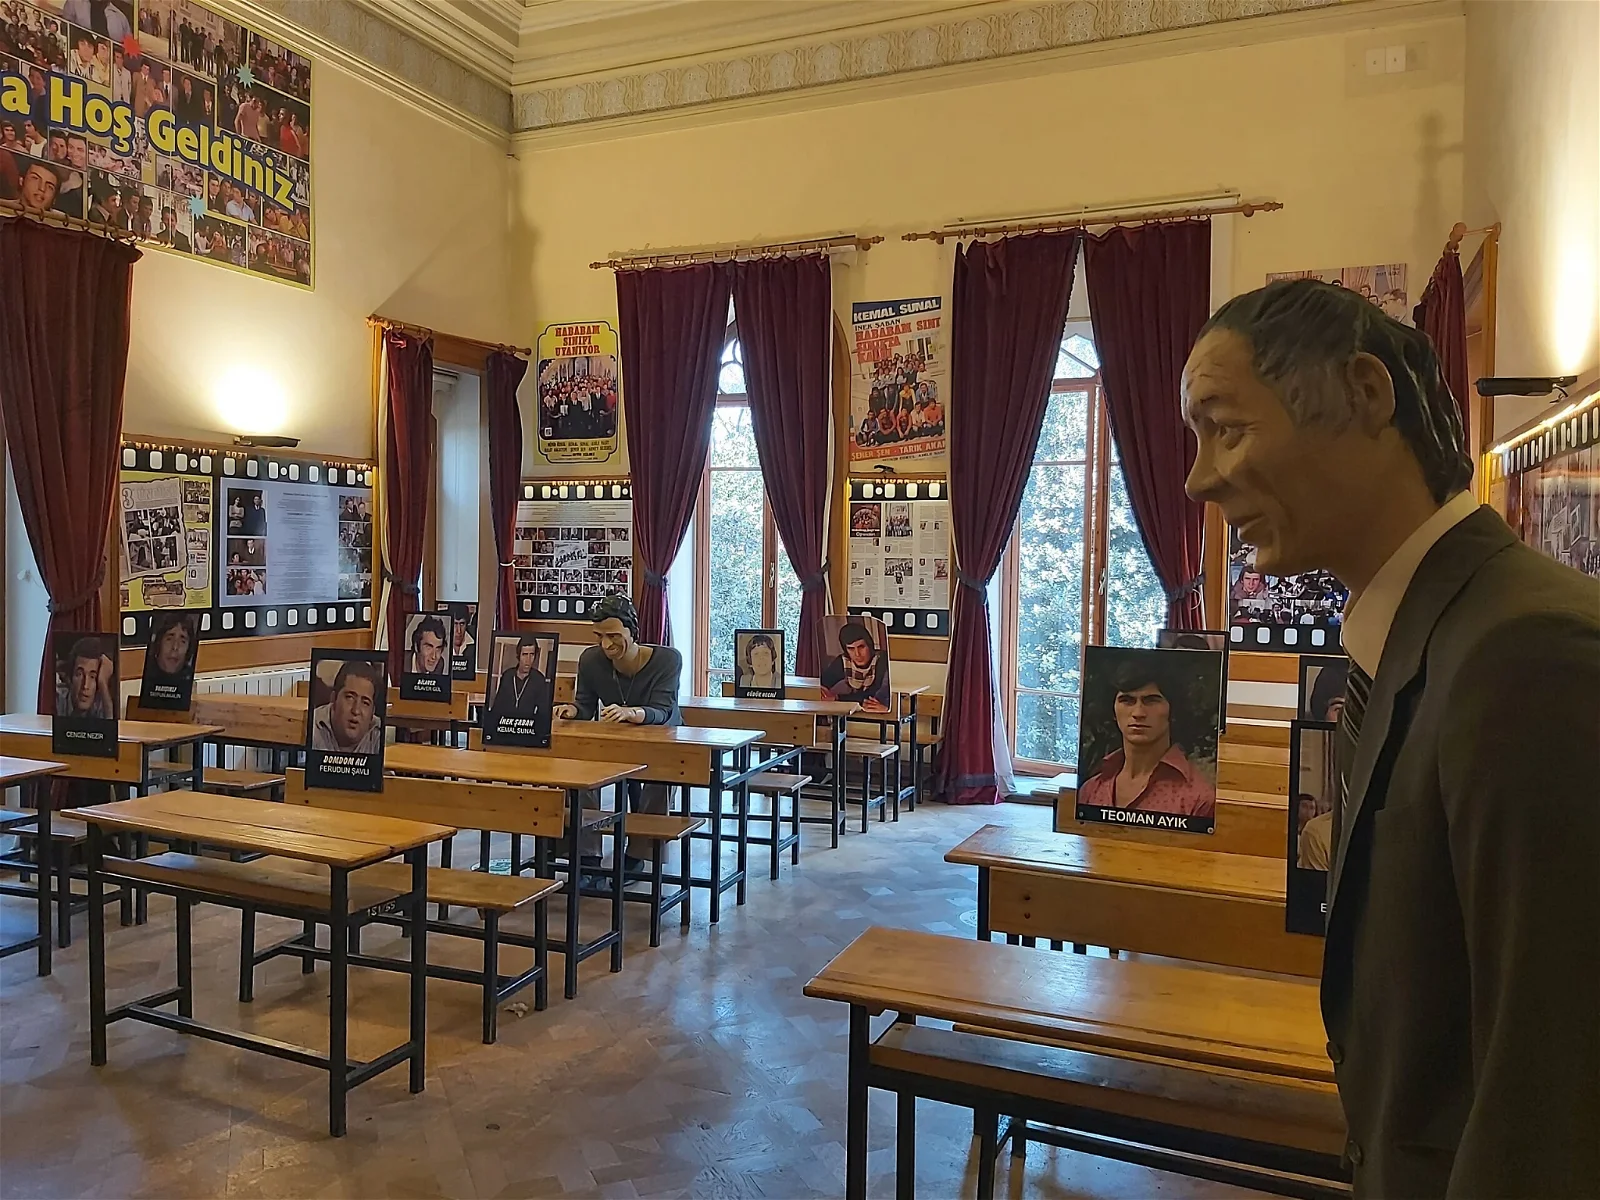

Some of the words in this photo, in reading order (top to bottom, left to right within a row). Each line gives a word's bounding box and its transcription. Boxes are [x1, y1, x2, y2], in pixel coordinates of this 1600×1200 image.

[49, 77, 133, 153] Hoş
[148, 109, 295, 211] Geldiniz
[853, 306, 896, 323] KEMAL
[899, 299, 940, 314] SUNAL
[555, 325, 600, 337] HABABAM
[855, 322, 912, 340] HABABAM
[563, 336, 592, 346] SINIFI
[555, 345, 600, 356] UYANIYOR
[899, 444, 923, 454] TARIK
[499, 715, 514, 726] İNEK
[496, 726, 516, 734] KEMAL
[516, 727, 536, 735] SUNAL
[323, 755, 355, 766] DOMDOM
[355, 756, 368, 767] ALİ
[1100, 808, 1155, 825] TEOMAN
[1157, 815, 1188, 829] AYIK
